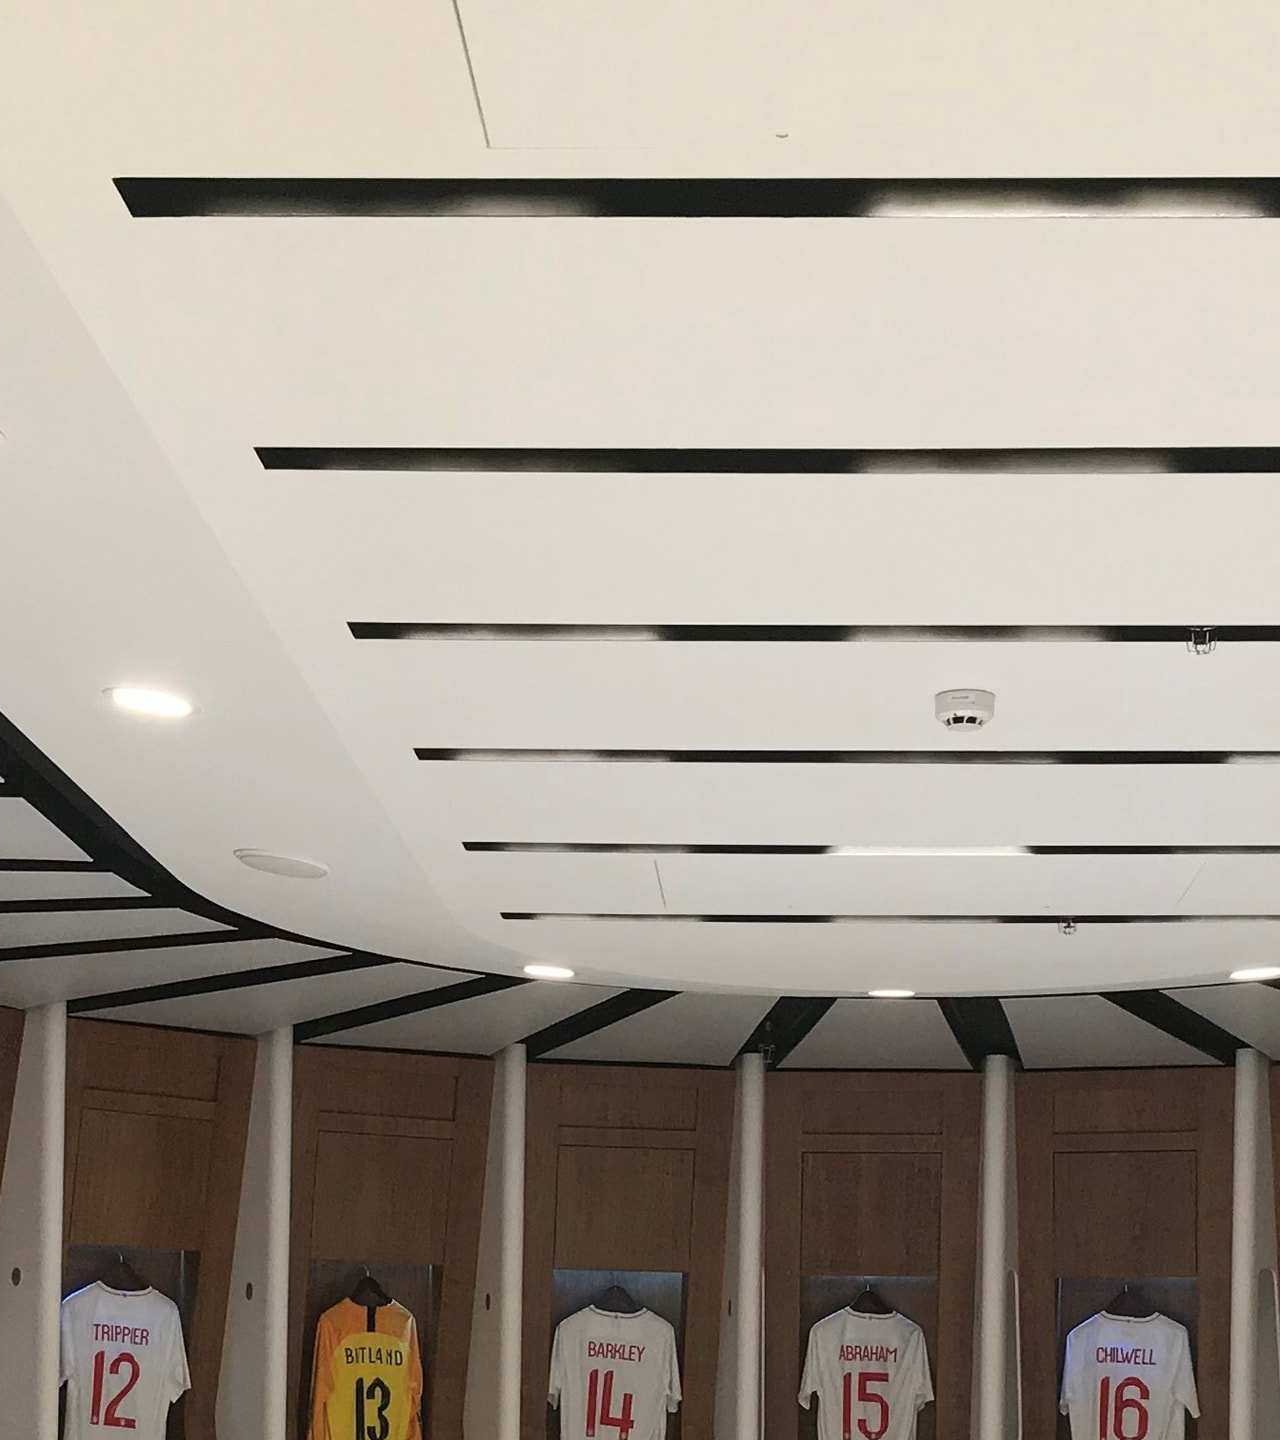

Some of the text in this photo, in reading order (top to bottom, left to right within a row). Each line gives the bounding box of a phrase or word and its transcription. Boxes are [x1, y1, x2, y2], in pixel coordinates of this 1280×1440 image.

[93, 1323, 150, 1346] TRIPPIER
[588, 1340, 646, 1362] BARKLEY
[839, 1344, 898, 1363] ABRAHAM
[1096, 1346, 1157, 1366] CHILWELL
[90, 1350, 140, 1429] 12
[585, 1369, 635, 1440] 14
[842, 1372, 890, 1440] 15
